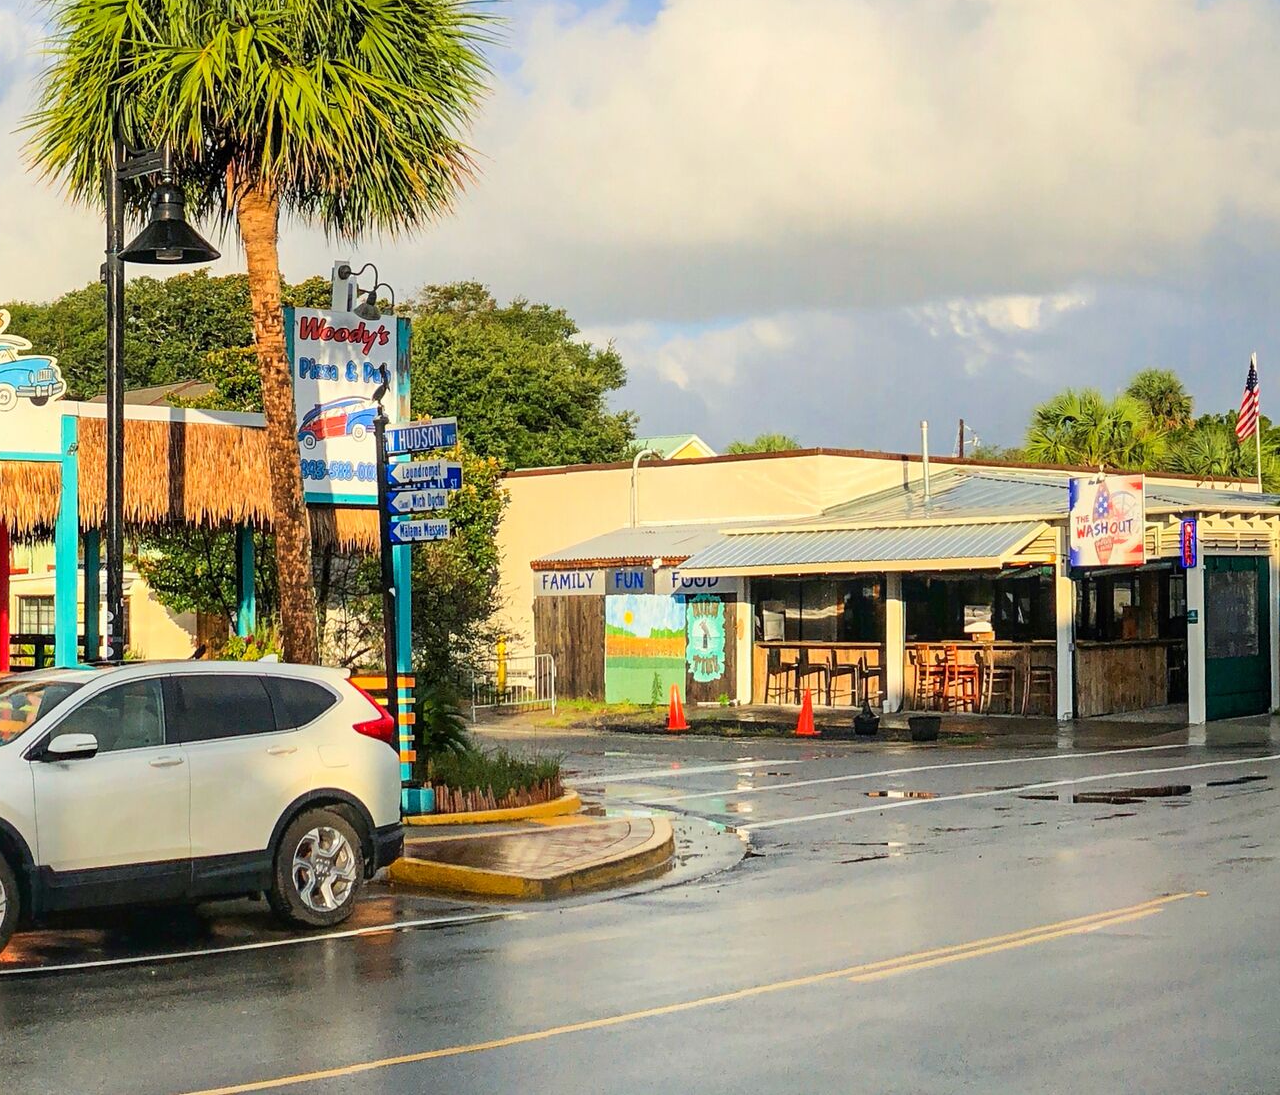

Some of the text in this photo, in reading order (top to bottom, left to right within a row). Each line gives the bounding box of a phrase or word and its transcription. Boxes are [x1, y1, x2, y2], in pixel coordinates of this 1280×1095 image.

[300, 316, 390, 356] Woody's
[299, 356, 338, 381] Pizza
[345, 360, 358, 382] &
[384, 431, 395, 452] W
[399, 426, 442, 450] HUDSON
[402, 463, 441, 479] Laundromat
[1076, 515, 1089, 523] THE
[424, 522, 447, 537] Massage
[542, 572, 594, 591] FAMILY
[615, 572, 644, 589] FUN
